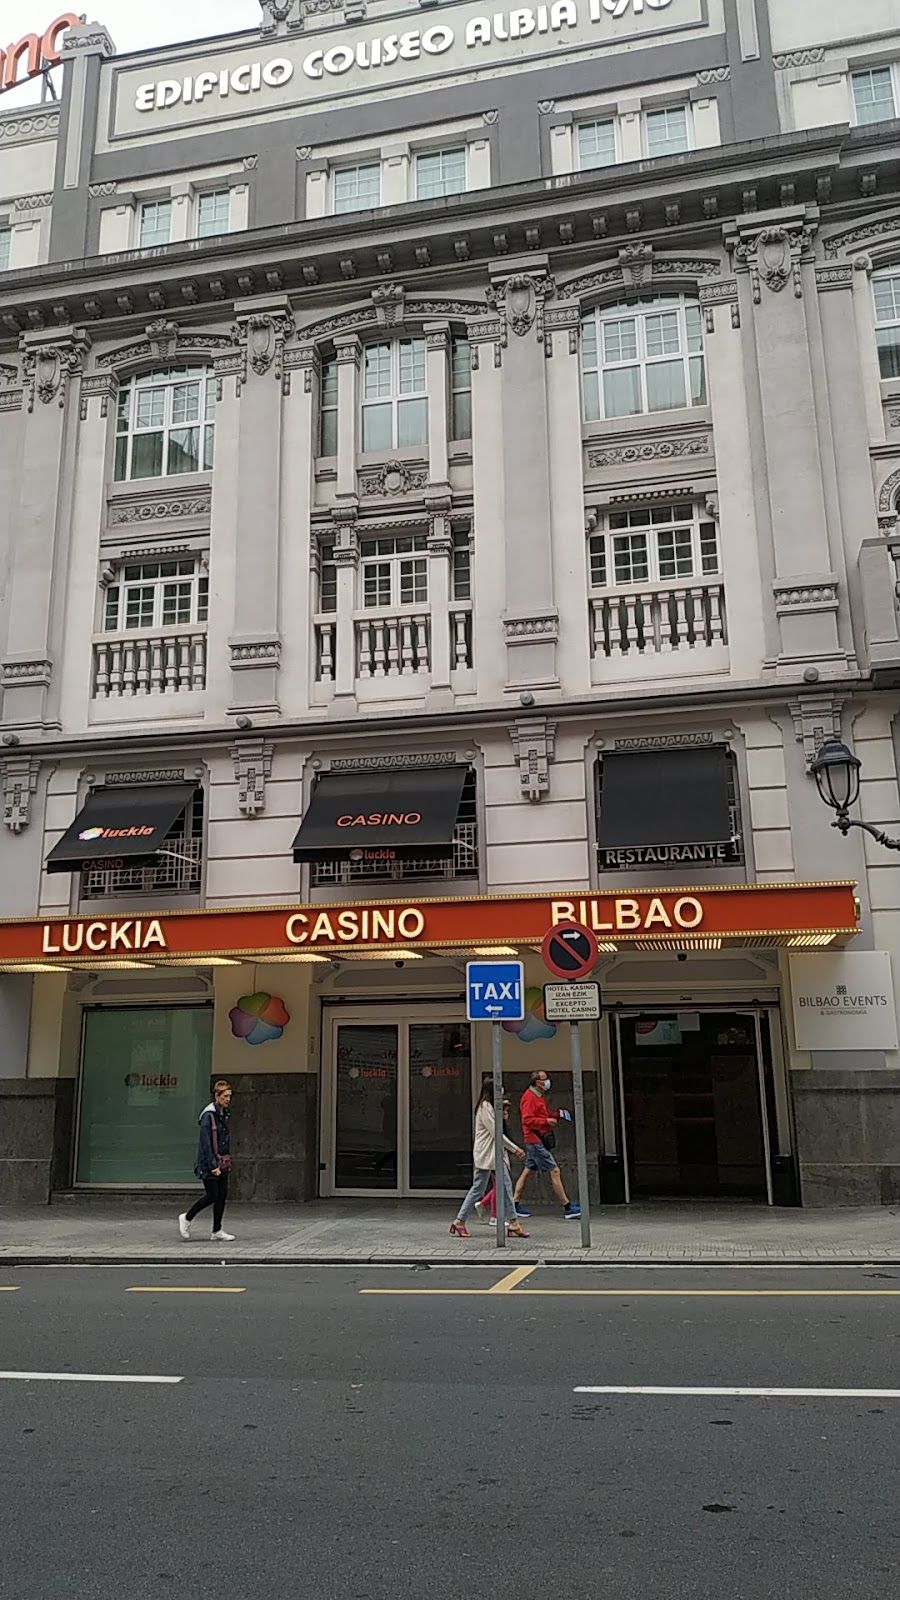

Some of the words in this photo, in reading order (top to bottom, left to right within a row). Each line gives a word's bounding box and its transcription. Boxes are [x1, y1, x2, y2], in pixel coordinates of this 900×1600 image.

[135, 57, 294, 112] EDIFICIO
[302, 25, 455, 79] COLISEO
[465, 0, 577, 48] ALBIA
[336, 812, 421, 827] CASINO
[103, 825, 156, 838] luckia
[364, 848, 396, 860] luckia
[605, 844, 726, 865] RESTAURANTE
[81, 858, 124, 871] CASINO
[42, 920, 167, 953] LUCKIA
[285, 907, 424, 944] CASINO
[551, 896, 704, 931] BILBAO
[470, 982, 520, 1000] TAXI
[799, 996, 840, 1007] BILBAO
[843, 995, 888, 1006] EVENTS
[141, 1073, 178, 1087] luckia
